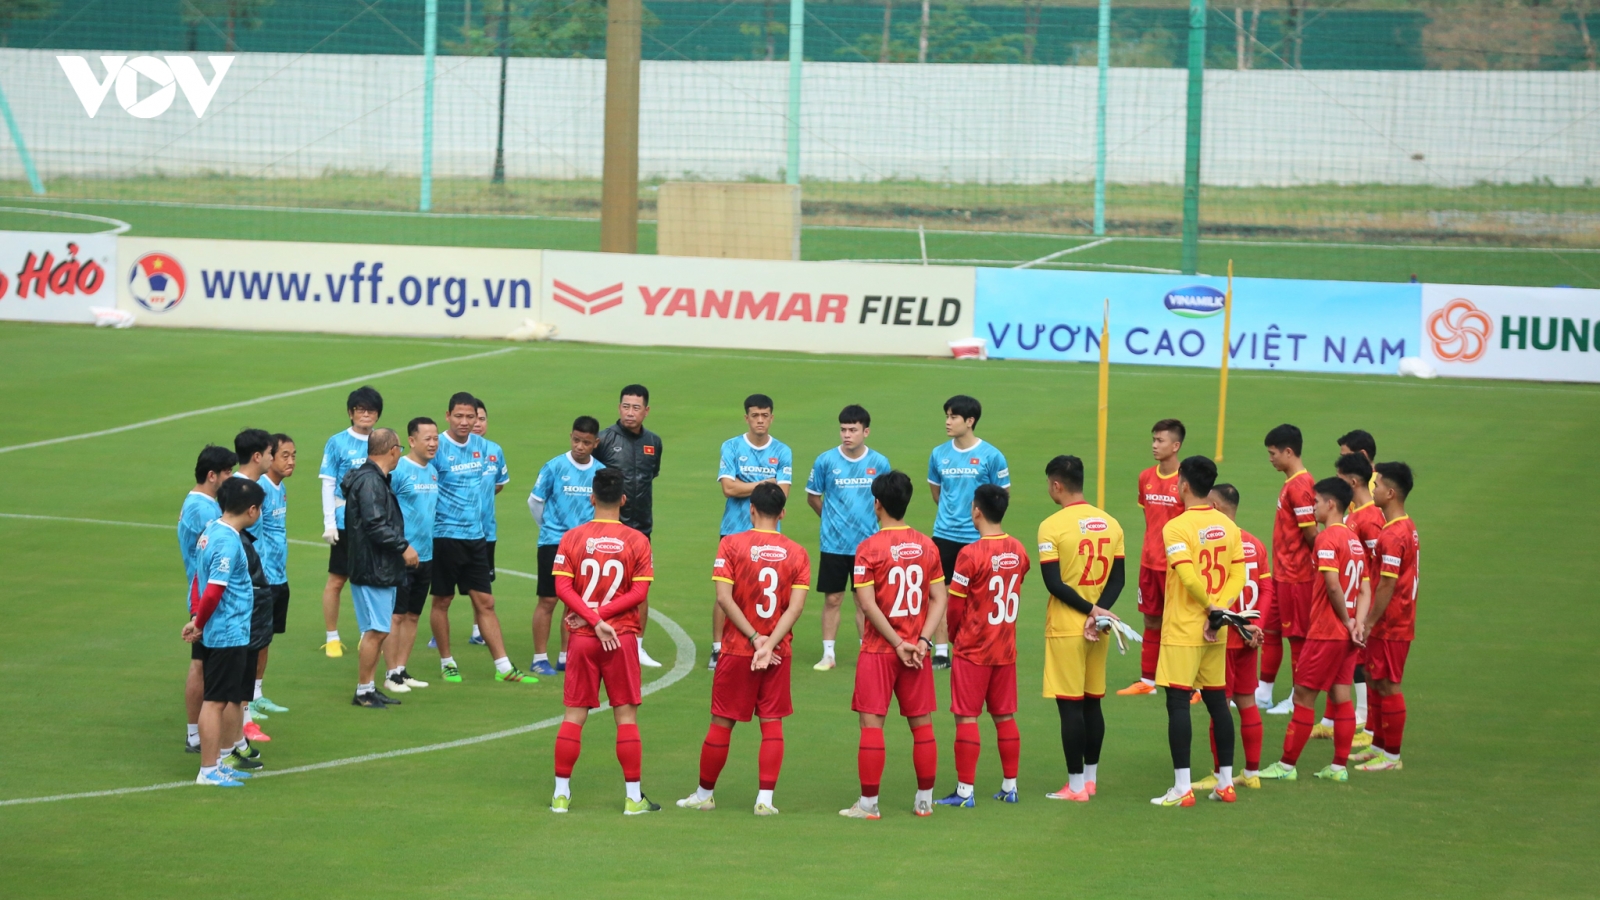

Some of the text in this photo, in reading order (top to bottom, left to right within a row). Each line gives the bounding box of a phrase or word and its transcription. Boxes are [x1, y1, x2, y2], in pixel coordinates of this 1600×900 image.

[17, 242, 105, 299] Hảo
[201, 262, 532, 318] www.vff.org.vn
[638, 285, 962, 327] YANMAR FIELD
[1168, 294, 1224, 307] VINAMILK
[1125, 327, 1205, 357] CAO
[1227, 323, 1308, 368] VIỆT
[1323, 335, 1405, 366] NAM
[450, 461, 483, 472] HONDA
[563, 485, 593, 493] HOND
[740, 465, 776, 474] HONDA
[942, 467, 979, 475] HONDA
[1145, 494, 1178, 504] HONDA
[581, 558, 624, 608] 22
[1078, 538, 1110, 587] 25
[1198, 545, 1227, 595] 35
[755, 567, 779, 619] 3
[888, 564, 923, 618] 28
[988, 573, 1019, 625] 36
